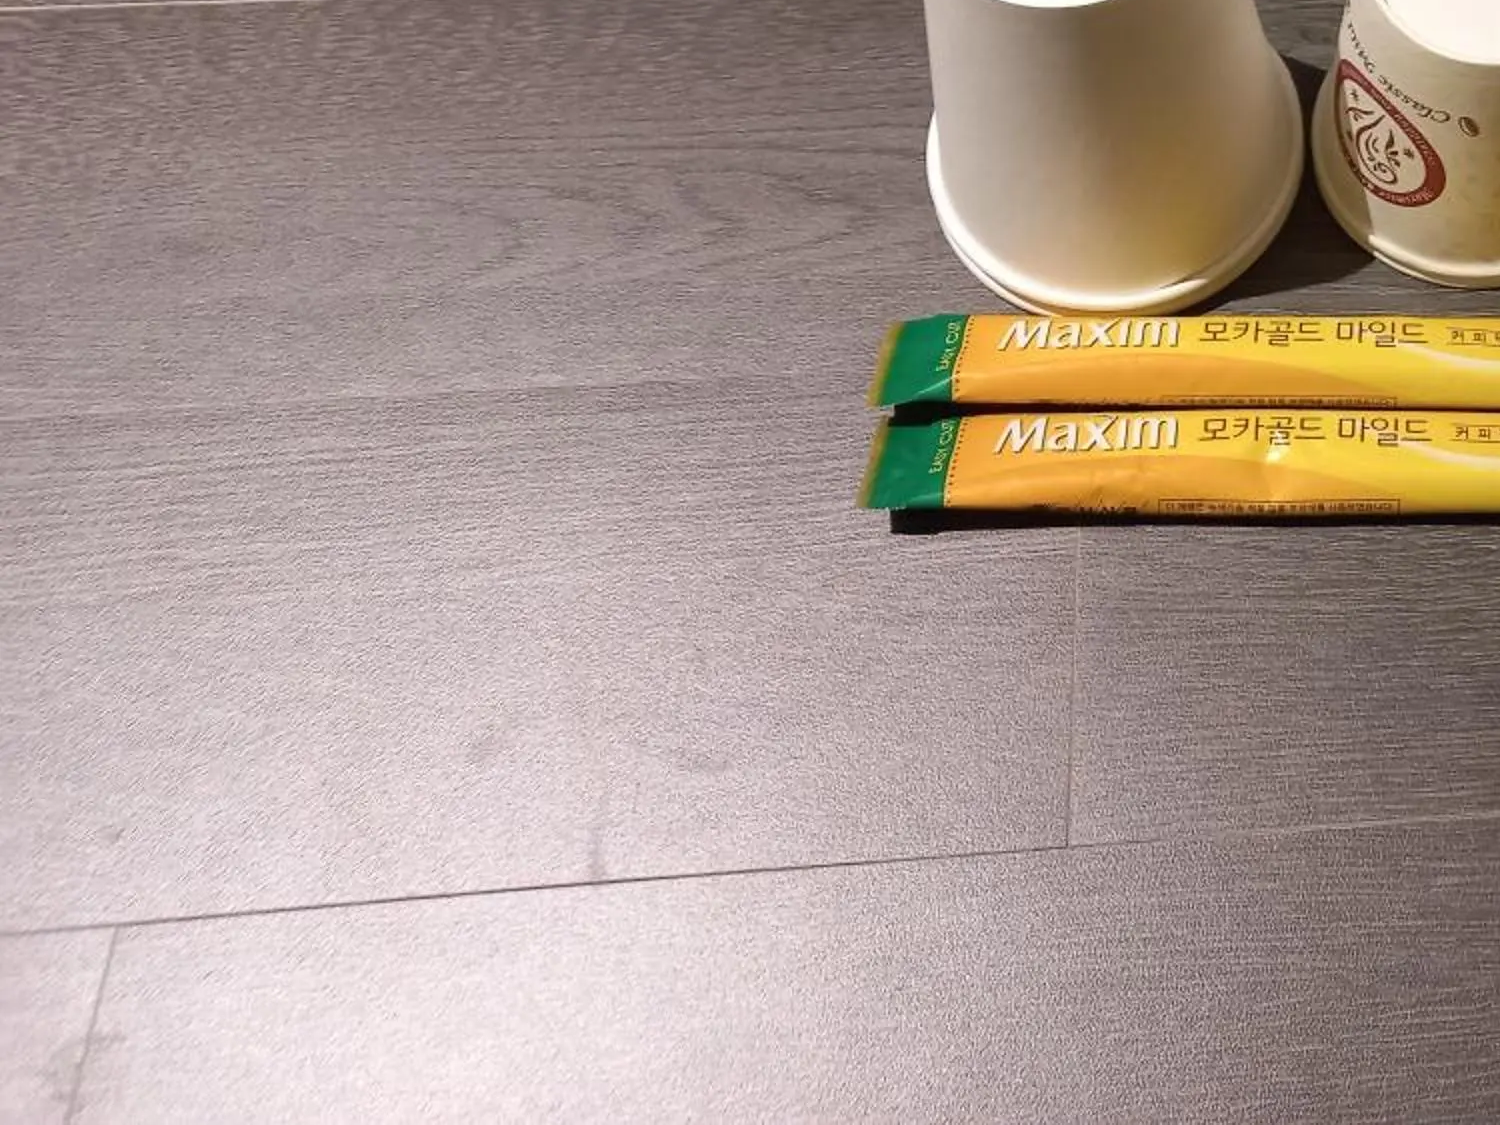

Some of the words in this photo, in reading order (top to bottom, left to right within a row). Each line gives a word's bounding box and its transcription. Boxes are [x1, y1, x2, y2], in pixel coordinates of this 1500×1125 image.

[1379, 75, 1451, 124] Classic
[996, 316, 1181, 352] Maxim
[1199, 321, 1325, 347] 모카골드
[1336, 321, 1429, 348] 마일드
[993, 415, 1179, 455] Maxim
[1198, 416, 1326, 446] 모카골드
[1338, 417, 1433, 448] 마일드
